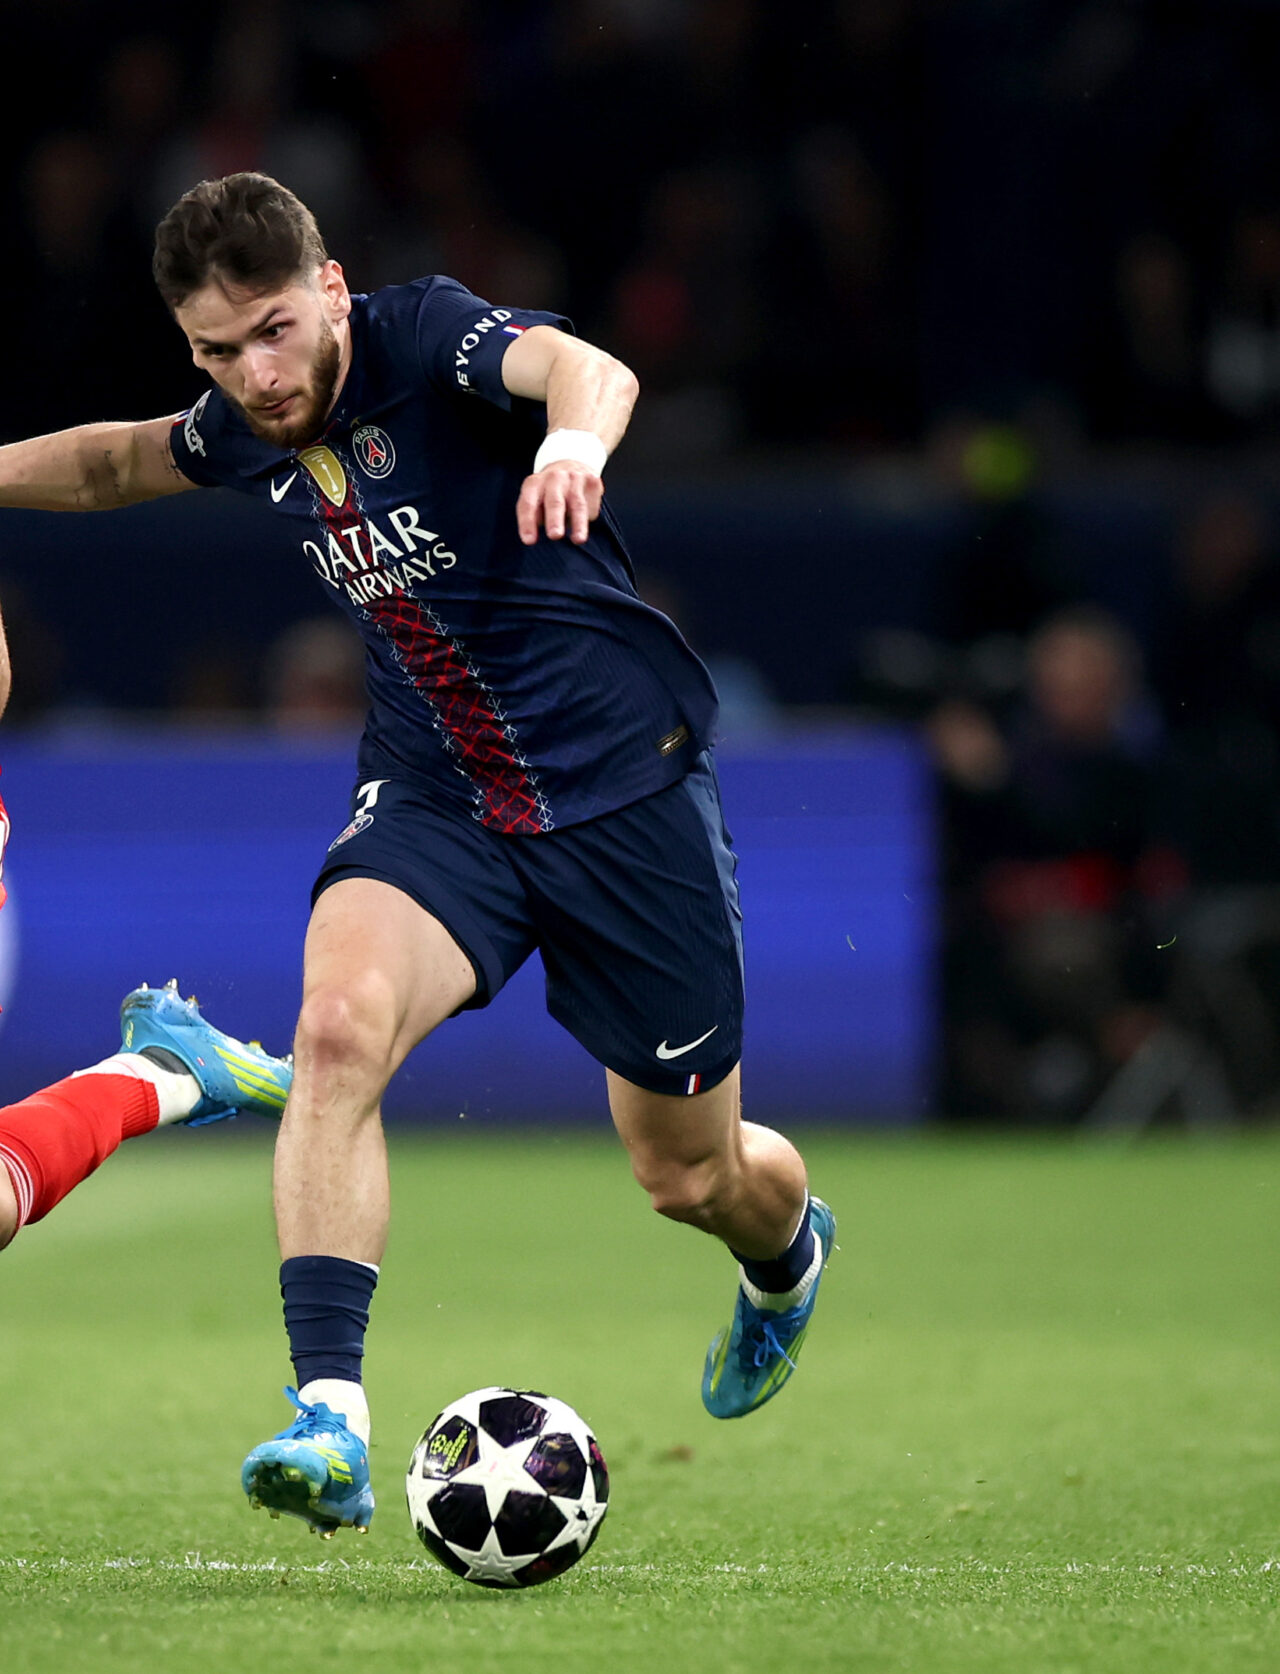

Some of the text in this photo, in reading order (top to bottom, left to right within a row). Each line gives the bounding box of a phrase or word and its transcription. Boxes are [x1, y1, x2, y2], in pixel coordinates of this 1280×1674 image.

[455, 309, 512, 394] EYOND
[354, 428, 380, 445] PARIS
[302, 505, 440, 590] QATAR
[344, 542, 457, 606] AIRWAYS
